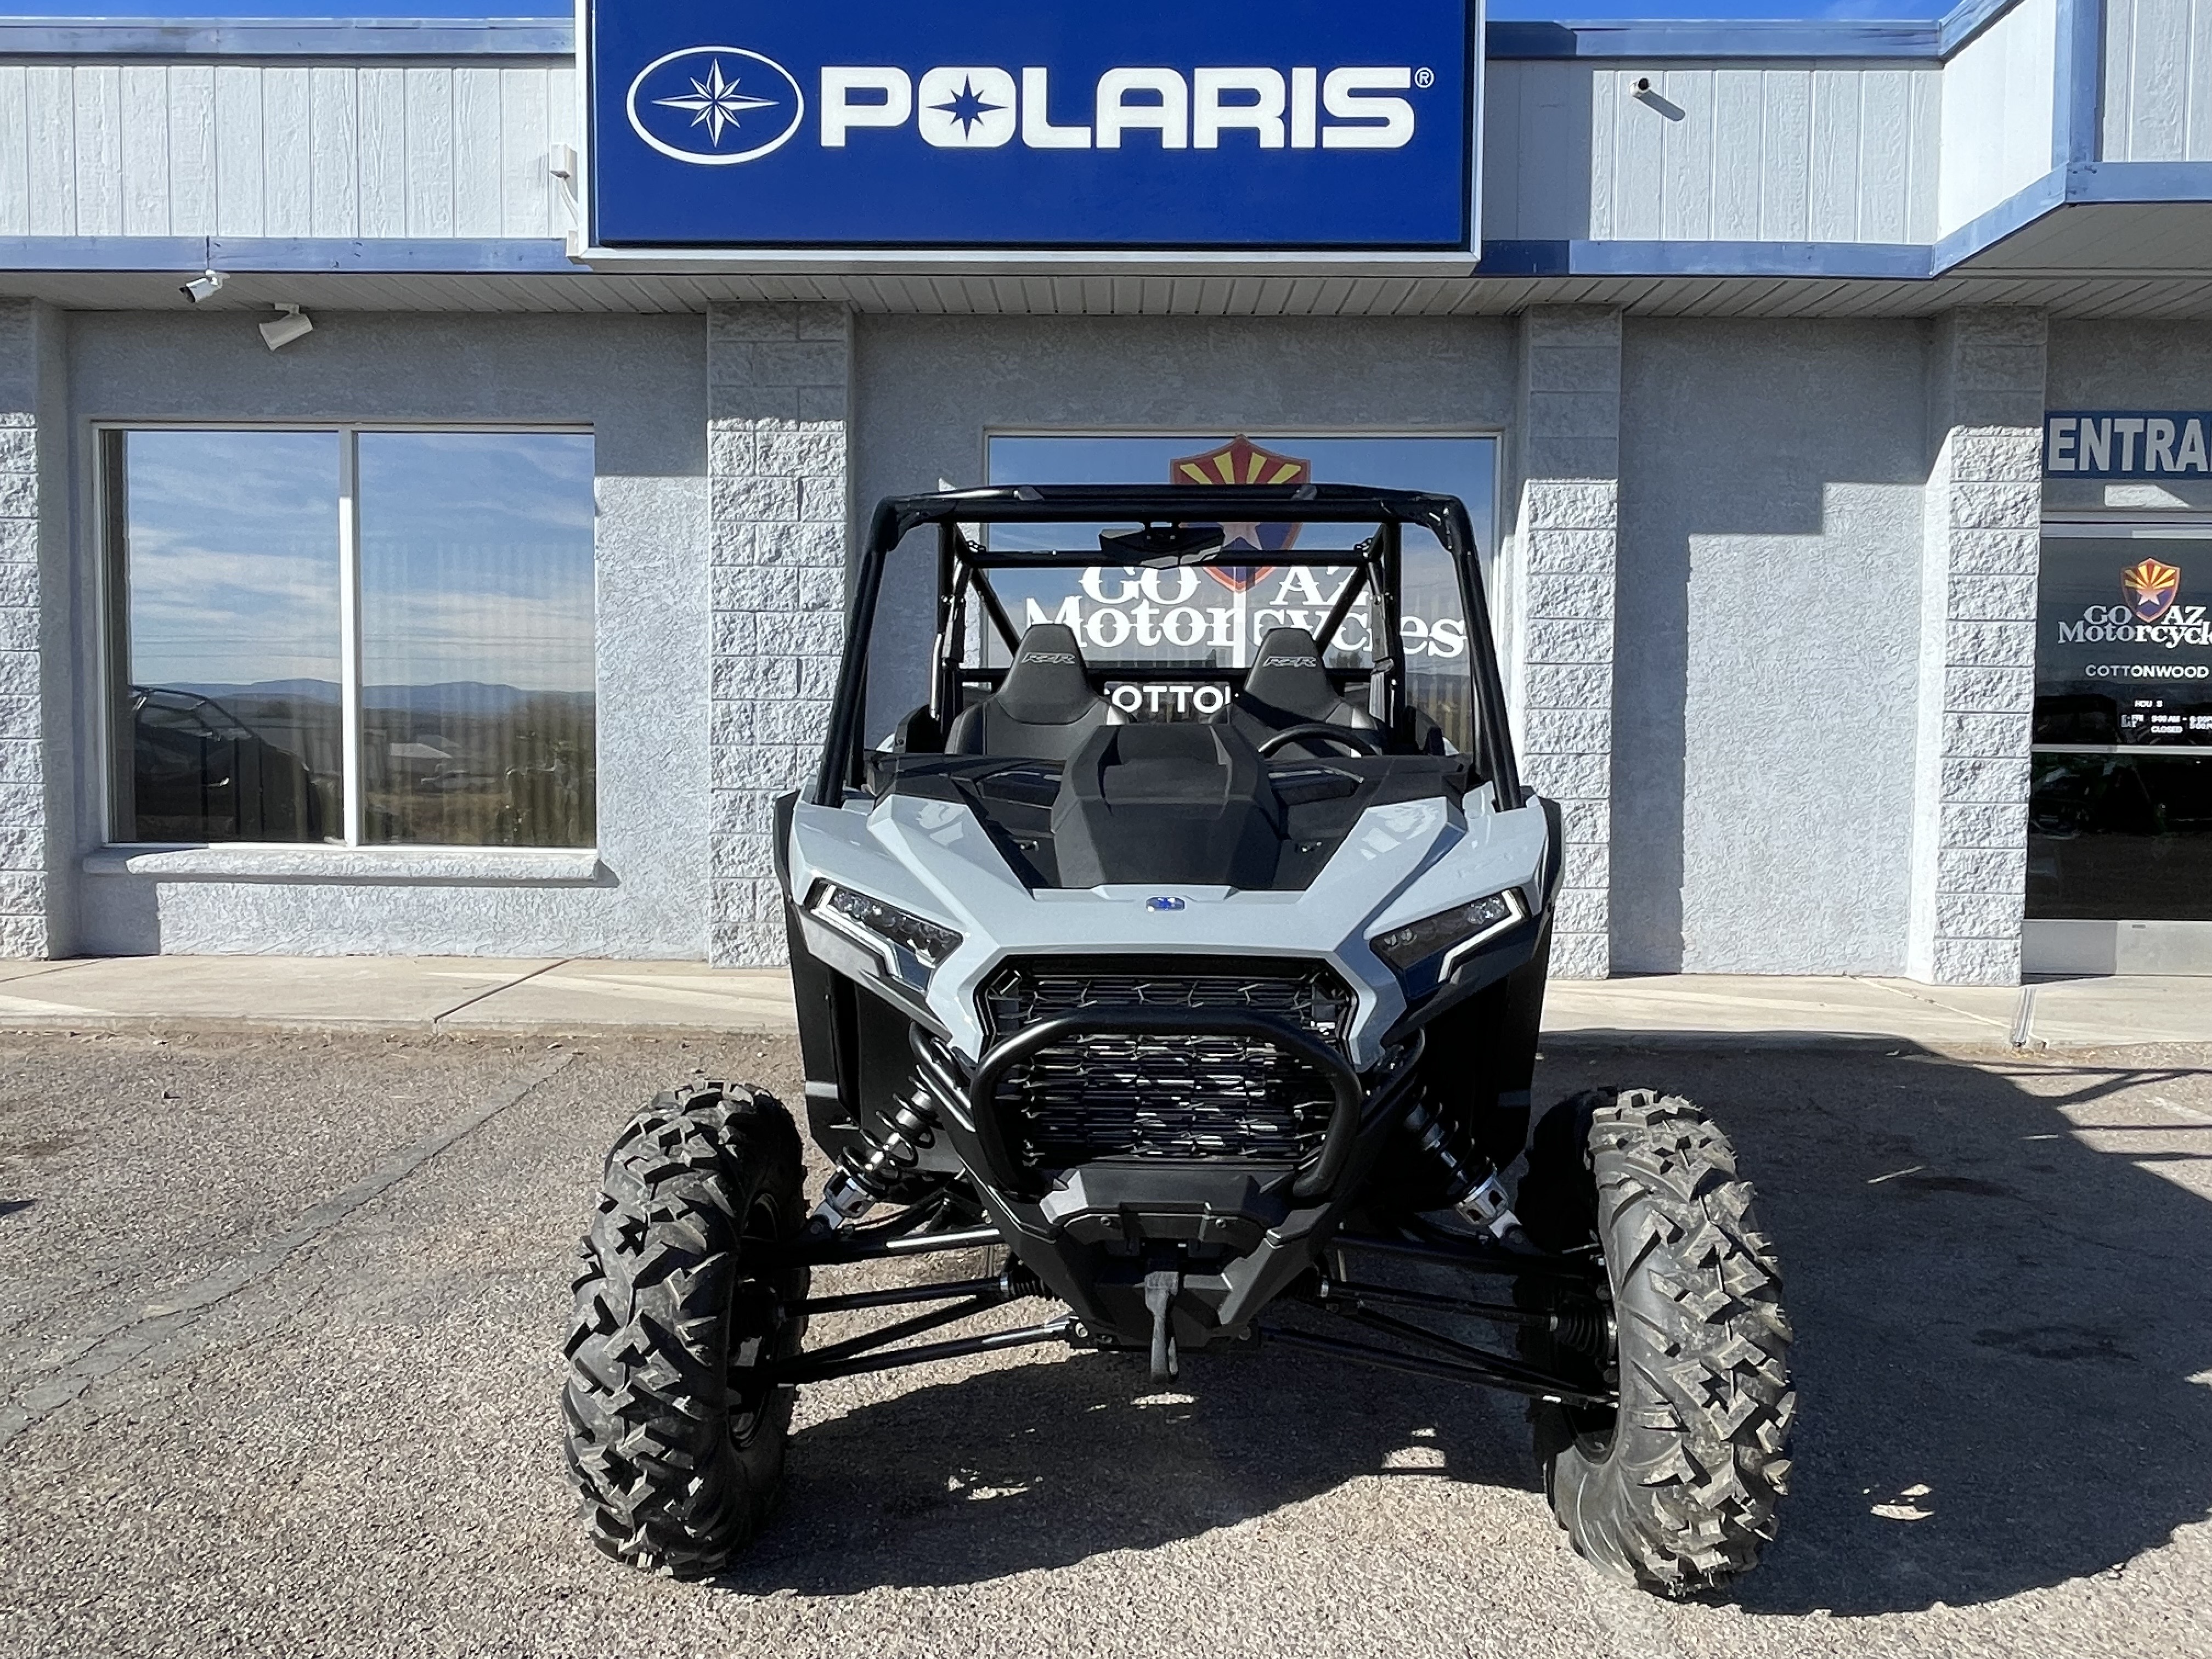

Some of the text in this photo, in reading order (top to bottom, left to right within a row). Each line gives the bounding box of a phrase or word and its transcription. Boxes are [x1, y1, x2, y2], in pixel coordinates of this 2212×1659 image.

[2049, 417, 2212, 472] ENTRA
[1077, 566, 1201, 605] GO
[1024, 595, 1468, 658] Motorcyces
[2084, 605, 2207, 626] GO AZ
[2085, 664, 2210, 679] COTTONWOOD
[1104, 685, 1231, 714] OTTO
